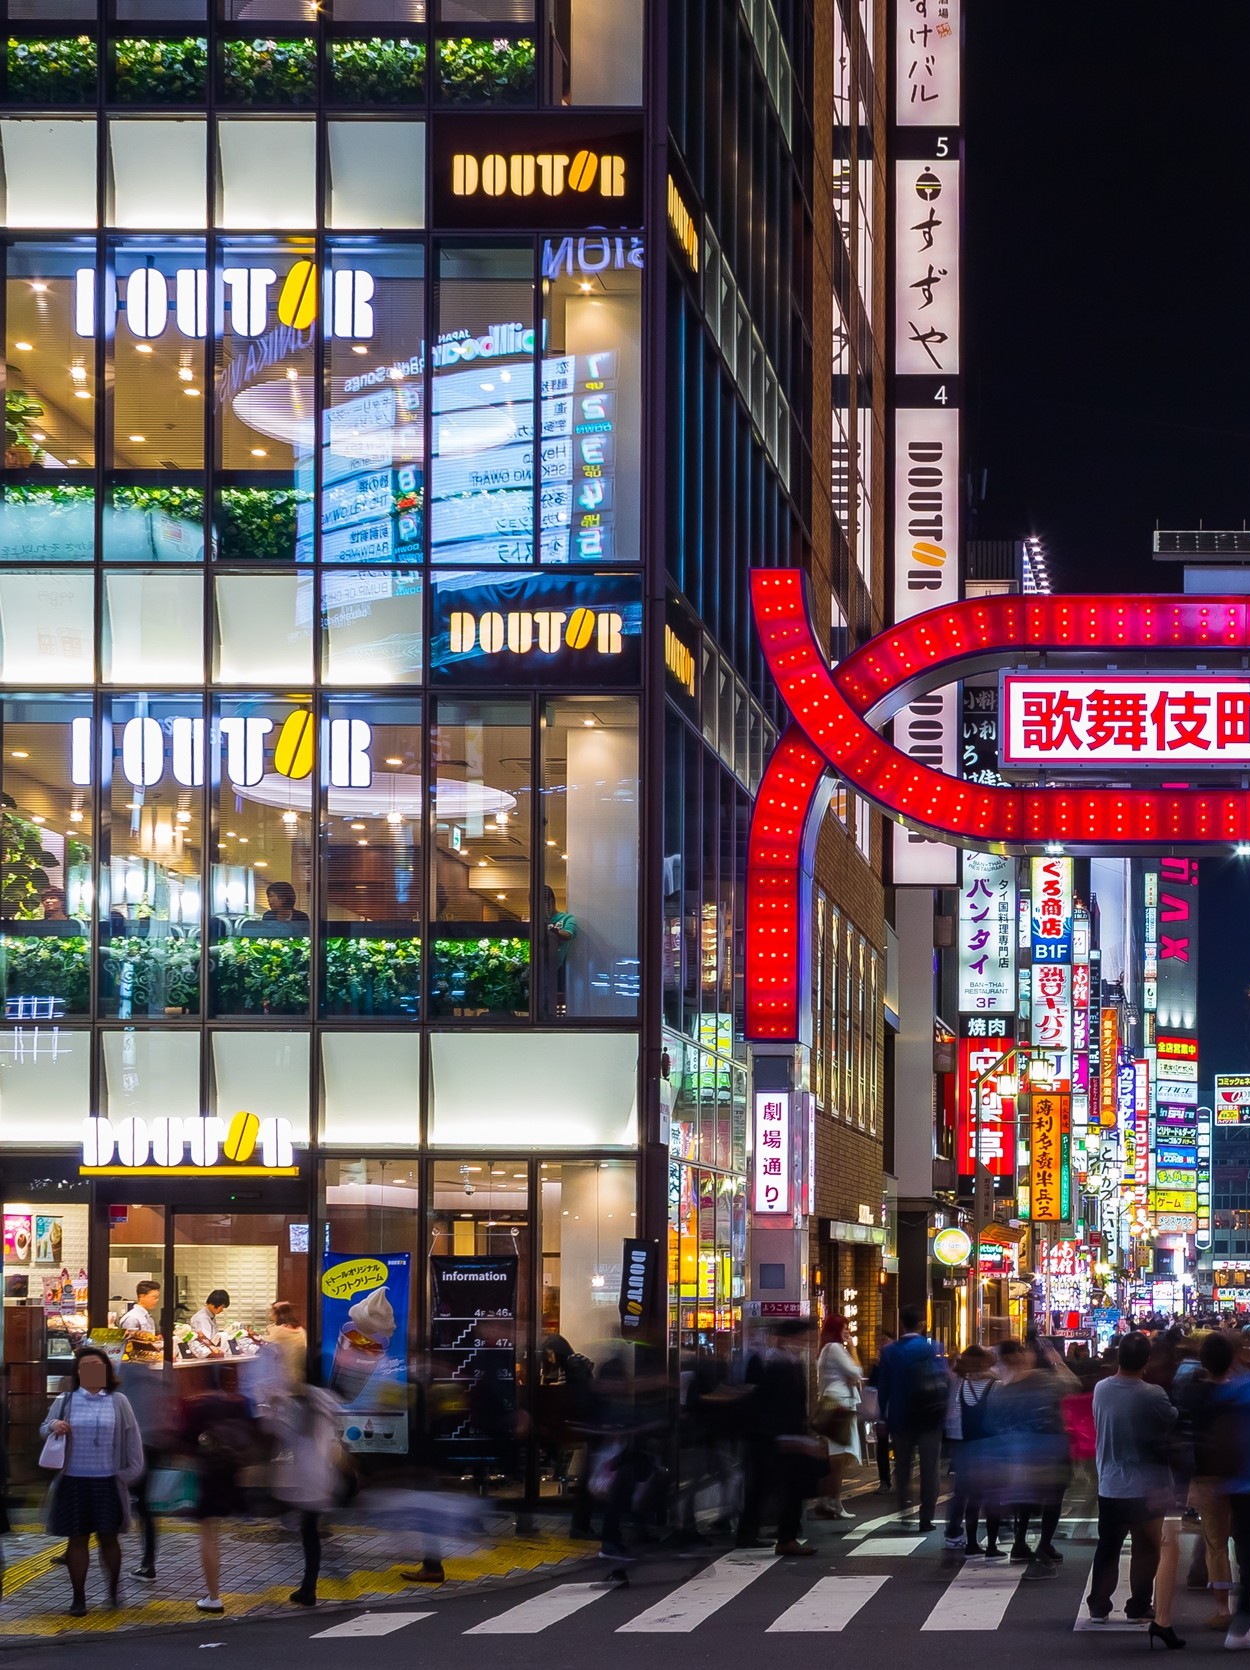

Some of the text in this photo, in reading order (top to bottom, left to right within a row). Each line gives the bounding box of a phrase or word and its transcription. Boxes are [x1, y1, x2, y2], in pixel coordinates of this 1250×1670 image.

[936, 136, 949, 158] 5
[453, 150, 625, 197] DOUTOR
[908, 207, 949, 370] すずや
[934, 385, 948, 405] 4
[907, 441, 947, 591] DOUTOR
[449, 607, 622, 654] DOUTOR
[966, 879, 993, 975] バンタイ
[998, 879, 1009, 969] タイ国料理専門店
[1035, 944, 1068, 959] B1F
[976, 997, 997, 1009] 3F
[968, 1018, 1006, 1037] 焼肉
[1157, 1041, 1196, 1056] 全店営業中
[81, 1111, 294, 1168] DOUTOR
[762, 1101, 782, 1203] 劇場通り
[325, 1263, 381, 1287] ドトールオリジナル
[331, 1272, 384, 1295] ソフトクリーム
[442, 1271, 508, 1282] information
[474, 1308, 486, 1317] 4F
[474, 1338, 486, 1347] 3F
